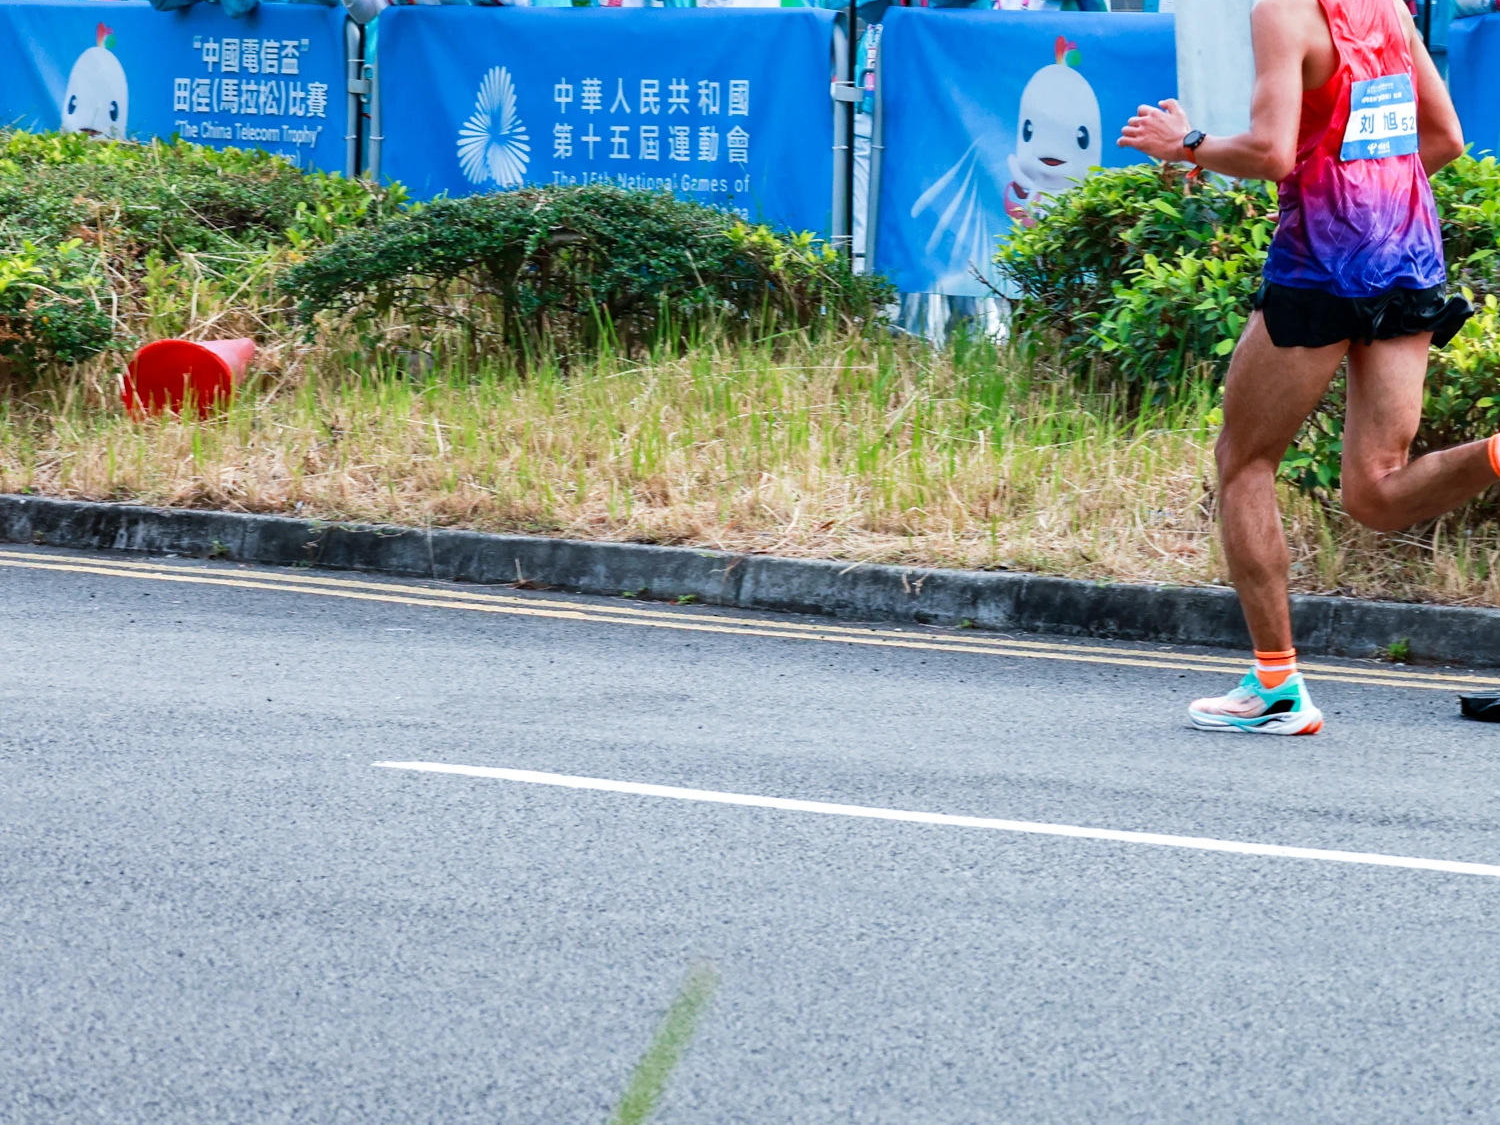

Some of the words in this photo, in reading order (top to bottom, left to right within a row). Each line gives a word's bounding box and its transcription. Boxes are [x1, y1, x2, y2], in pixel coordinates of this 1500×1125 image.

[174, 77, 328, 118] 田徑(馬拉松)比賽
[554, 77, 749, 117] 中華人民共和國
[201, 121, 232, 140] China
[234, 123, 280, 142] Telecom
[553, 122, 750, 164] 第十五屆運動會
[681, 173, 728, 192] Games
[735, 174, 750, 193] of
